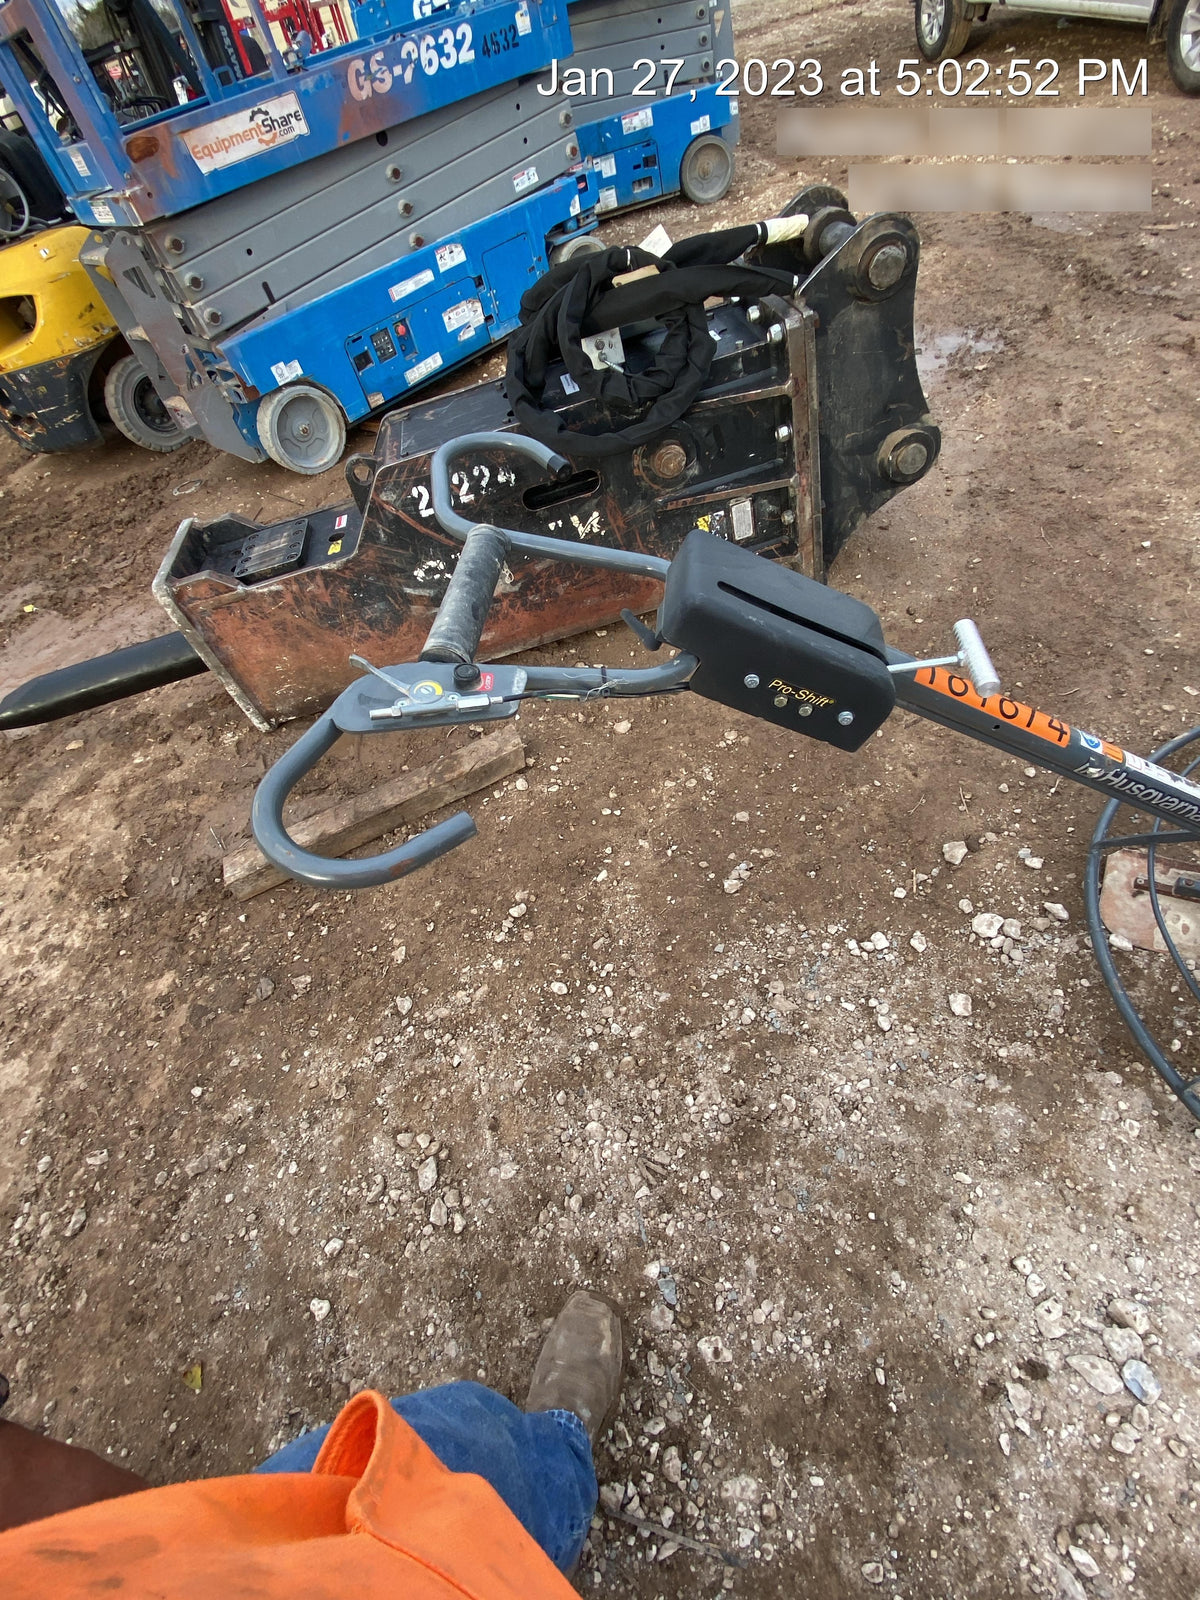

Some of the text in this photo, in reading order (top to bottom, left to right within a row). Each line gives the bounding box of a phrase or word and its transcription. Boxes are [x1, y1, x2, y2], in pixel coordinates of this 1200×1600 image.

[482, 24, 519, 58] 4632
[191, 109, 302, 160] EquipmentShare
[279, 126, 296, 138] .com
[768, 679, 829, 708] Pro-Shift
